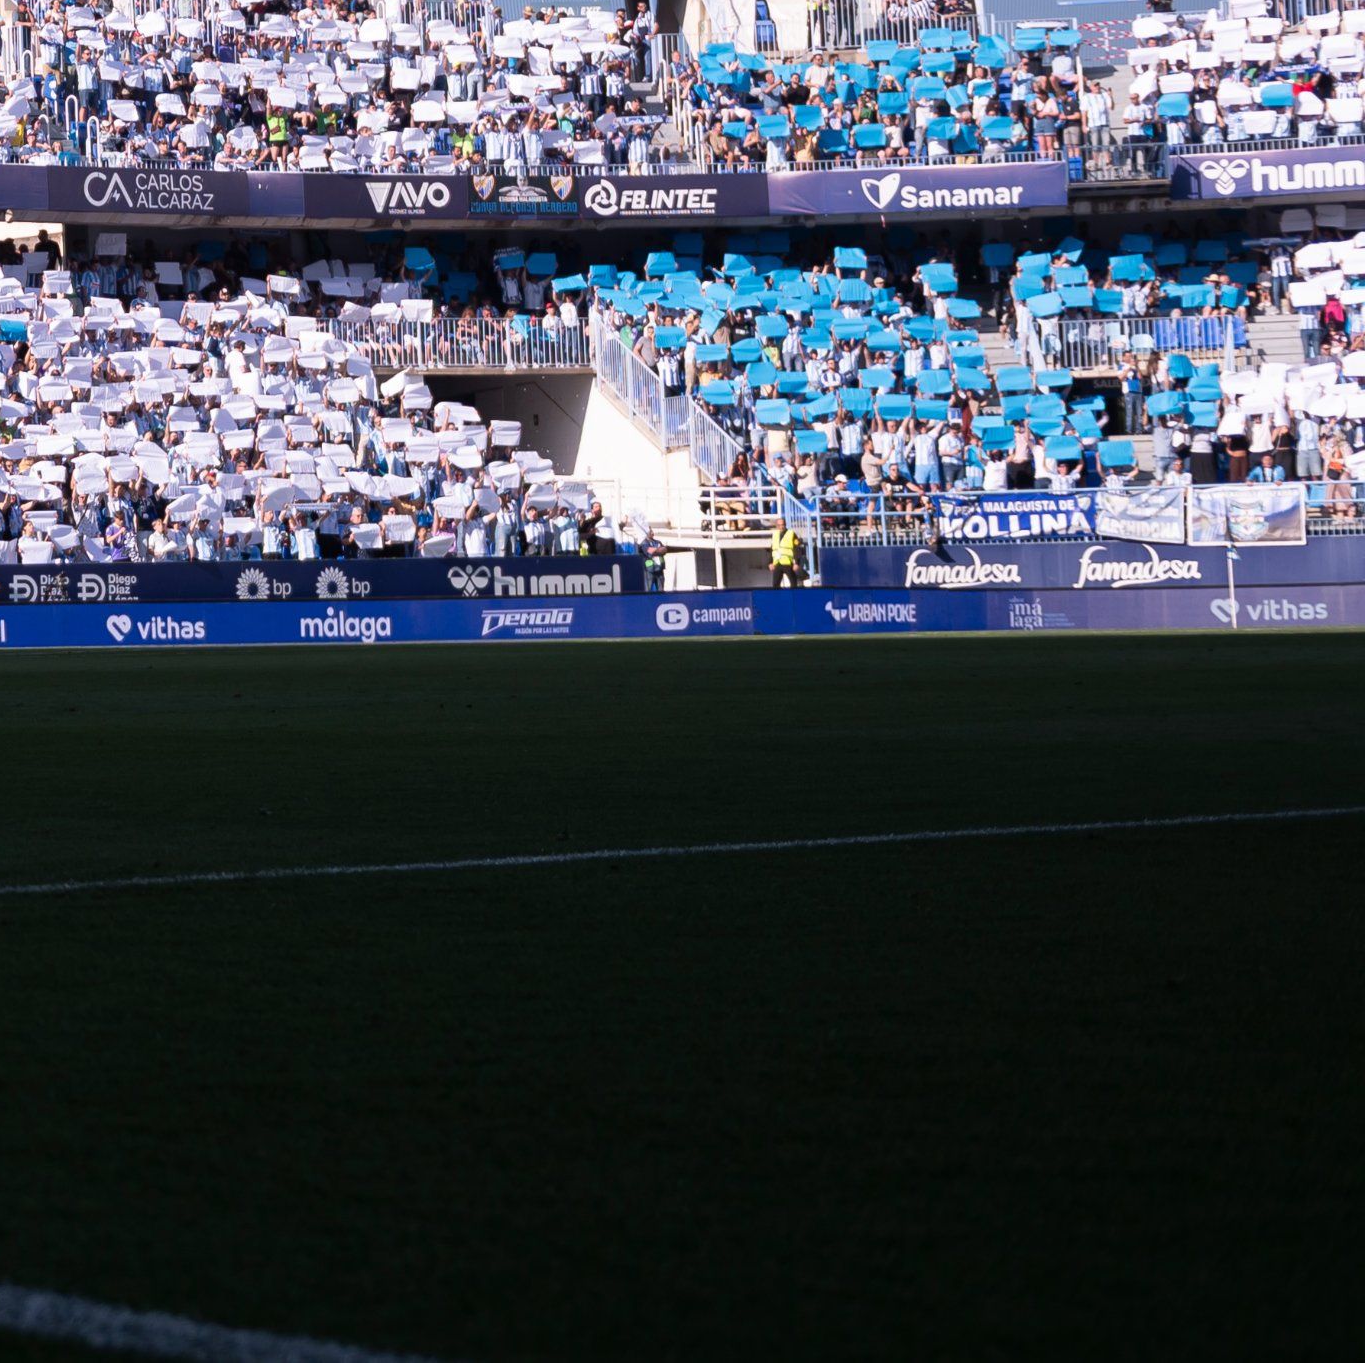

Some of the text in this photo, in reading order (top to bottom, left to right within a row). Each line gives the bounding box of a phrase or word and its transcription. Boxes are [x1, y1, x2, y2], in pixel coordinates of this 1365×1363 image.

[135, 173, 203, 192] CARLOS
[136, 192, 214, 210] ALCARAZ
[901, 184, 1024, 210] Sanamar
[983, 500, 1054, 513] MALAGUISTA
[1056, 500, 1076, 511] DE
[905, 547, 1022, 588] famadesa
[1073, 544, 1202, 588] famadesa
[108, 574, 137, 585] Diego
[273, 579, 291, 598] bp
[352, 576, 370, 597] bp
[108, 584, 131, 595] Díaz
[692, 607, 751, 625] campano
[849, 603, 917, 622] URBAN POKE
[1248, 602, 1328, 621] vithas
[138, 617, 205, 639] vithas
